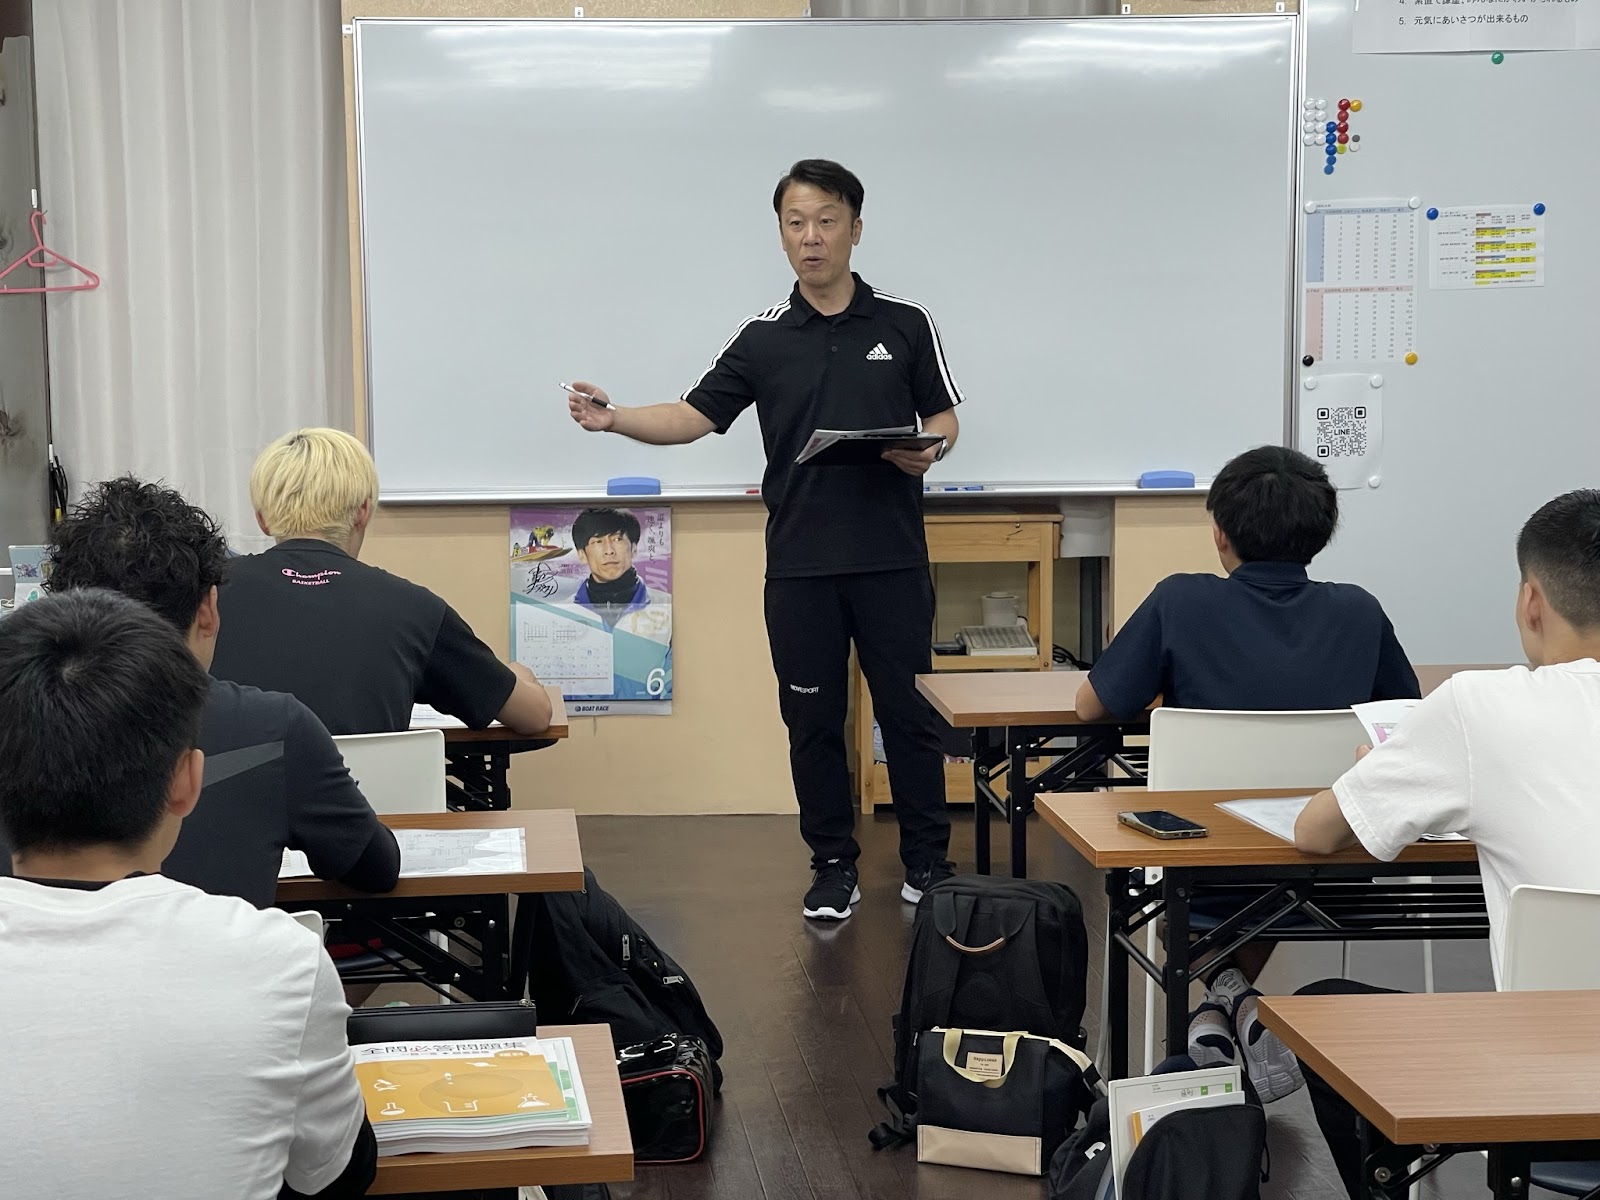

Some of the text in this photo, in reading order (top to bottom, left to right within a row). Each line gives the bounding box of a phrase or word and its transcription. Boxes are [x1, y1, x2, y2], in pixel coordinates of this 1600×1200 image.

[1398, 14, 1529, 25] 5. 元気にあいさつが出来るもの
[281, 568, 342, 580] Champion
[646, 667, 665, 696] 6
